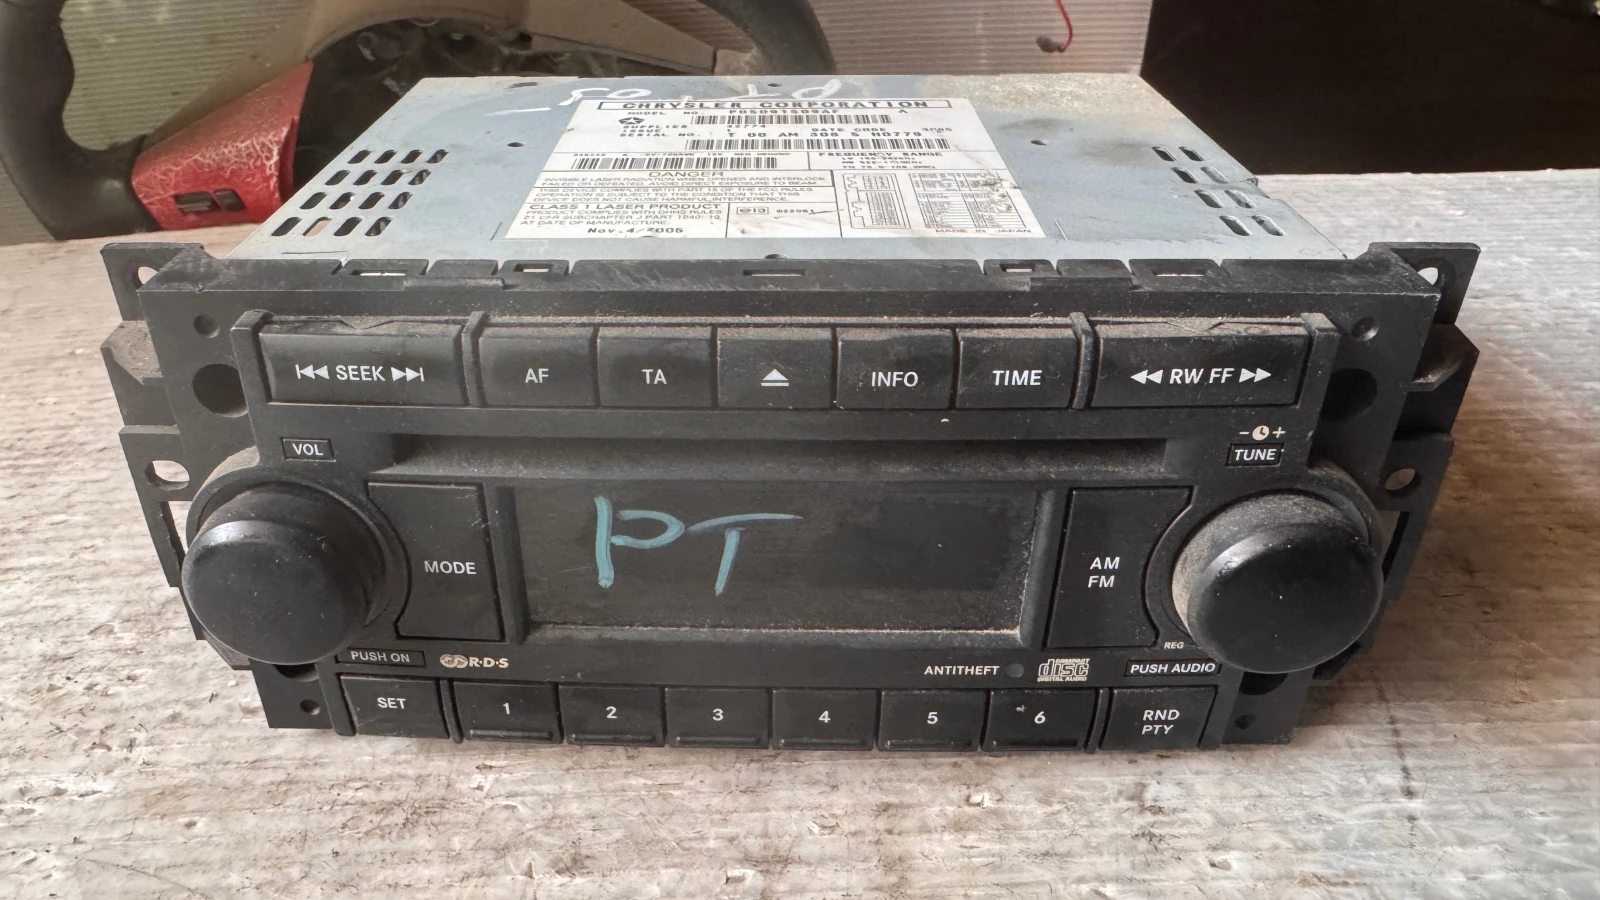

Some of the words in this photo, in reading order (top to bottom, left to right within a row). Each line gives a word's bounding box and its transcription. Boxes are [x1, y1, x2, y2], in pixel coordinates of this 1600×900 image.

[759, 101, 929, 109] CORPORATION
[336, 365, 385, 381] SEEK
[525, 368, 548, 383] AF
[642, 369, 666, 384] TA
[993, 370, 1042, 385] TIME
[1170, 369, 1204, 384] RW
[1209, 368, 1234, 383] FF
[872, 372, 918, 387] INFO
[292, 444, 323, 455] VOL
[1235, 449, 1276, 460] TUNE
[593, 495, 804, 596] PT
[425, 561, 476, 574] MODE
[1090, 557, 1119, 569] AM
[1088, 576, 1114, 587] FM
[351, 651, 387, 661] PUSH
[391, 653, 410, 662] ON
[924, 666, 999, 675] ANTITHEFT
[1131, 664, 1168, 673] PUSH
[1171, 663, 1215, 672] AUDIO
[378, 697, 406, 709] SET
[503, 703, 510, 714] 1
[607, 706, 617, 718] 2
[713, 709, 723, 721] 3
[819, 711, 830, 723] 4
[927, 712, 937, 724] 5
[1035, 711, 1045, 723] 6
[1143, 710, 1179, 720] RND
[1142, 725, 1173, 734] PTY
